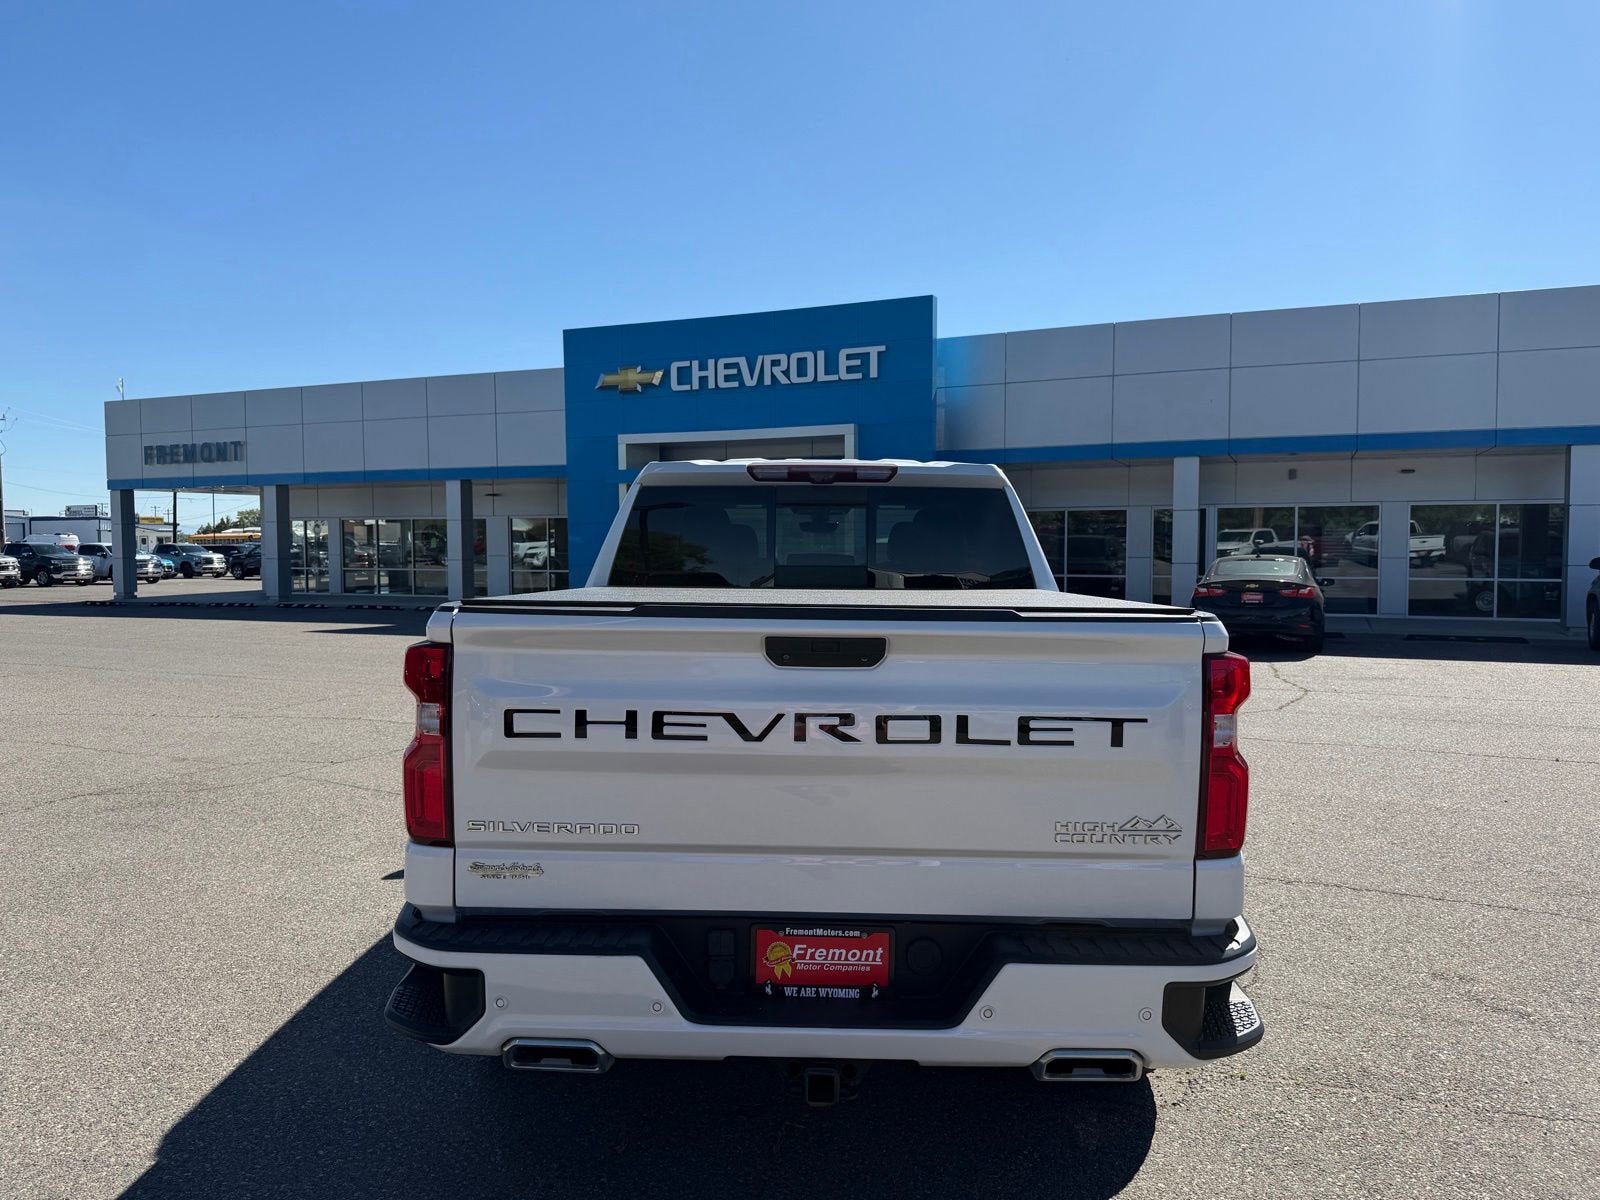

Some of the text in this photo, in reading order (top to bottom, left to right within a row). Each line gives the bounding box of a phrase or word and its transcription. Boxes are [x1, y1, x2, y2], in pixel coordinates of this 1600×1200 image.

[670, 344, 886, 392] CHEVROLET
[143, 440, 246, 465] FREMONT
[503, 707, 1149, 748] CHEVROLET
[466, 820, 640, 835] SILVERADO
[1054, 821, 1119, 833] HIGH
[1054, 833, 1182, 844] COUNTRY
[785, 928, 861, 937] FremontMotors.com
[793, 944, 883, 962] Fremont
[796, 963, 871, 972] Motor Companies
[784, 987, 860, 998] WE ARE WYOMING
